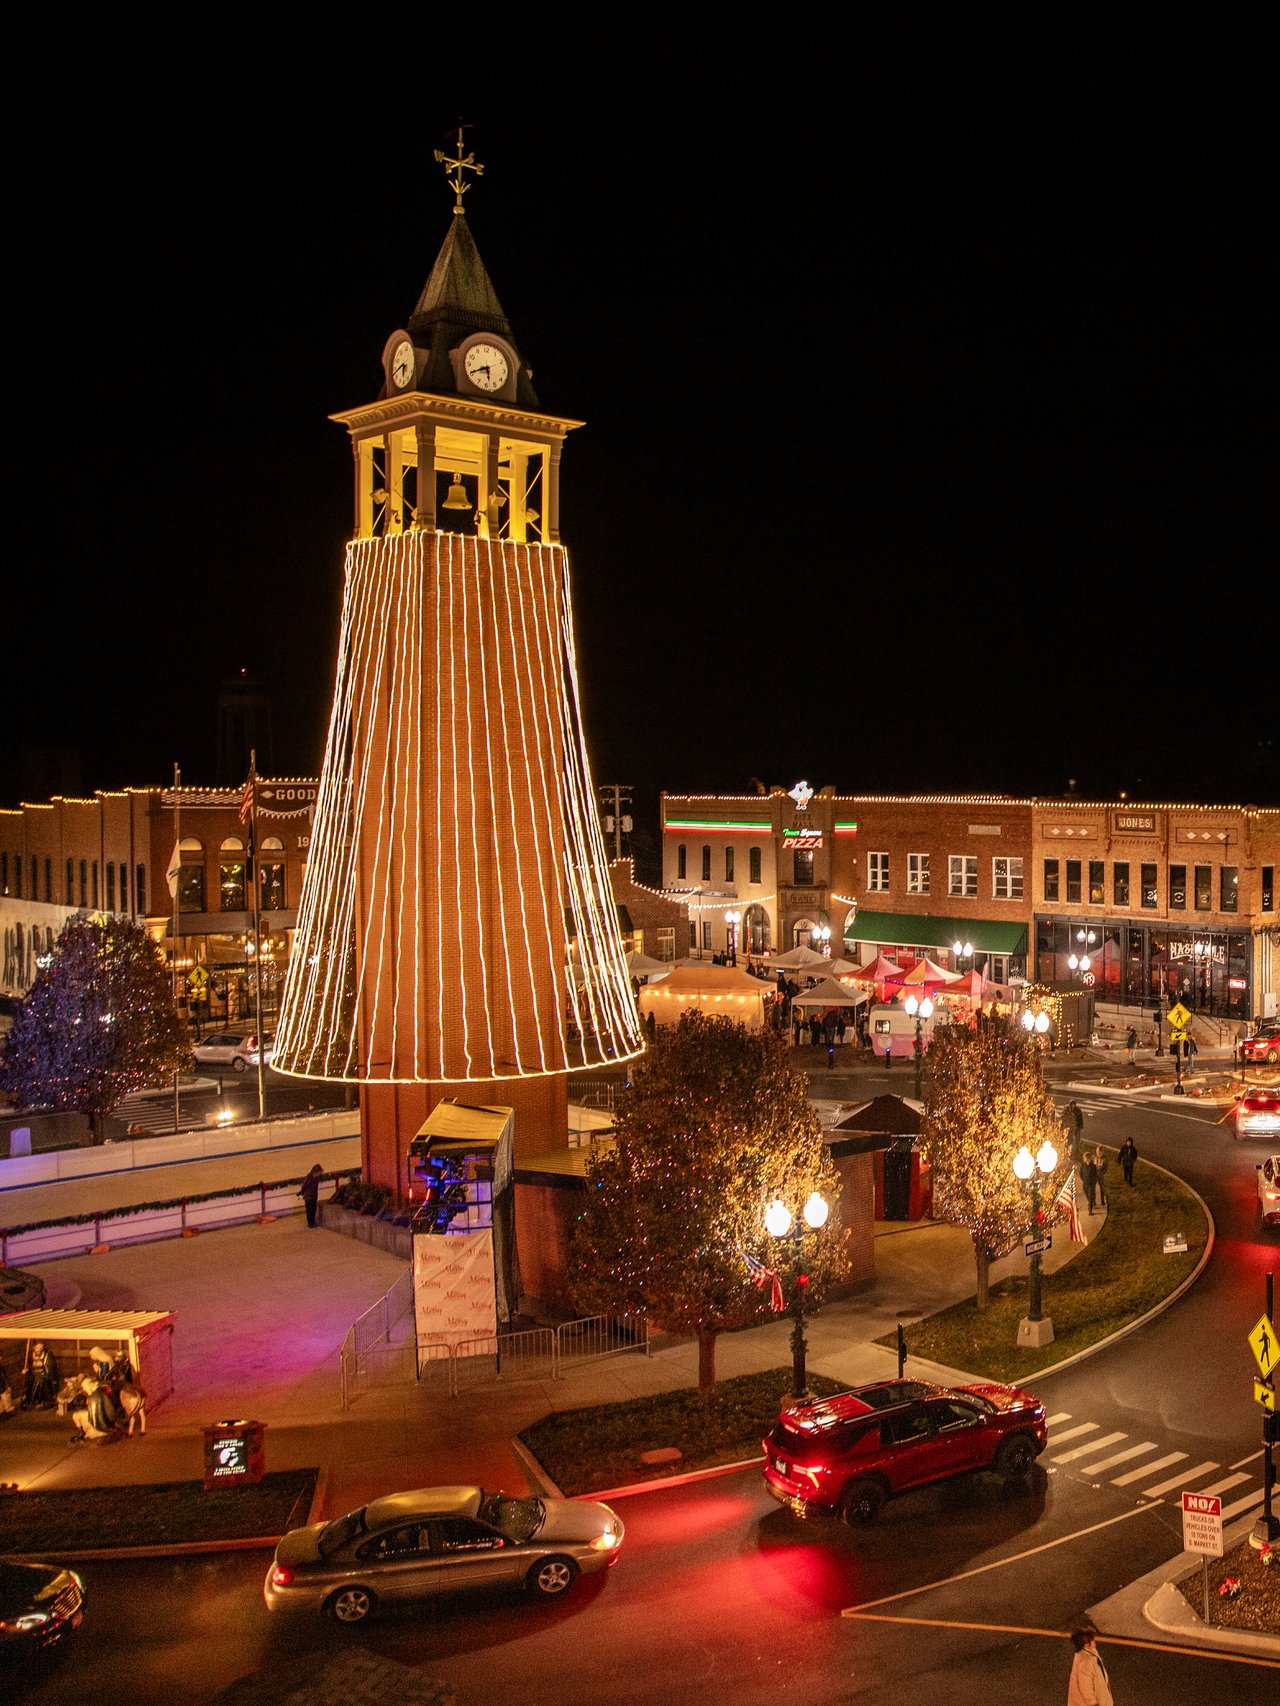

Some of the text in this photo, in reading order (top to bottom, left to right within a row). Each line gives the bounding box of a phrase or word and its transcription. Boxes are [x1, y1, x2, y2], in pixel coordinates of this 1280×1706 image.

[1119, 817, 1152, 828] JONES
[782, 838, 823, 849] PIZZA
[444, 1241, 464, 1249] Merry
[420, 1253, 441, 1262] Merry
[445, 1264, 464, 1273] Merry
[420, 1280, 441, 1289] Merry
[468, 1275, 490, 1285] Merry
[444, 1290, 467, 1300] Merry
[421, 1306, 442, 1315] Merry
[470, 1302, 492, 1311] Merry
[446, 1317, 468, 1326] Merry
[423, 1333, 443, 1341] Merry
[472, 1328, 493, 1337] Merry
[1190, 1514, 1207, 1523] TRUCKS
[1186, 1523, 1220, 1534] VEHICLES OVER
[1197, 1532, 1208, 1540] TONS
[1194, 1540, 1211, 1549] MARKET
